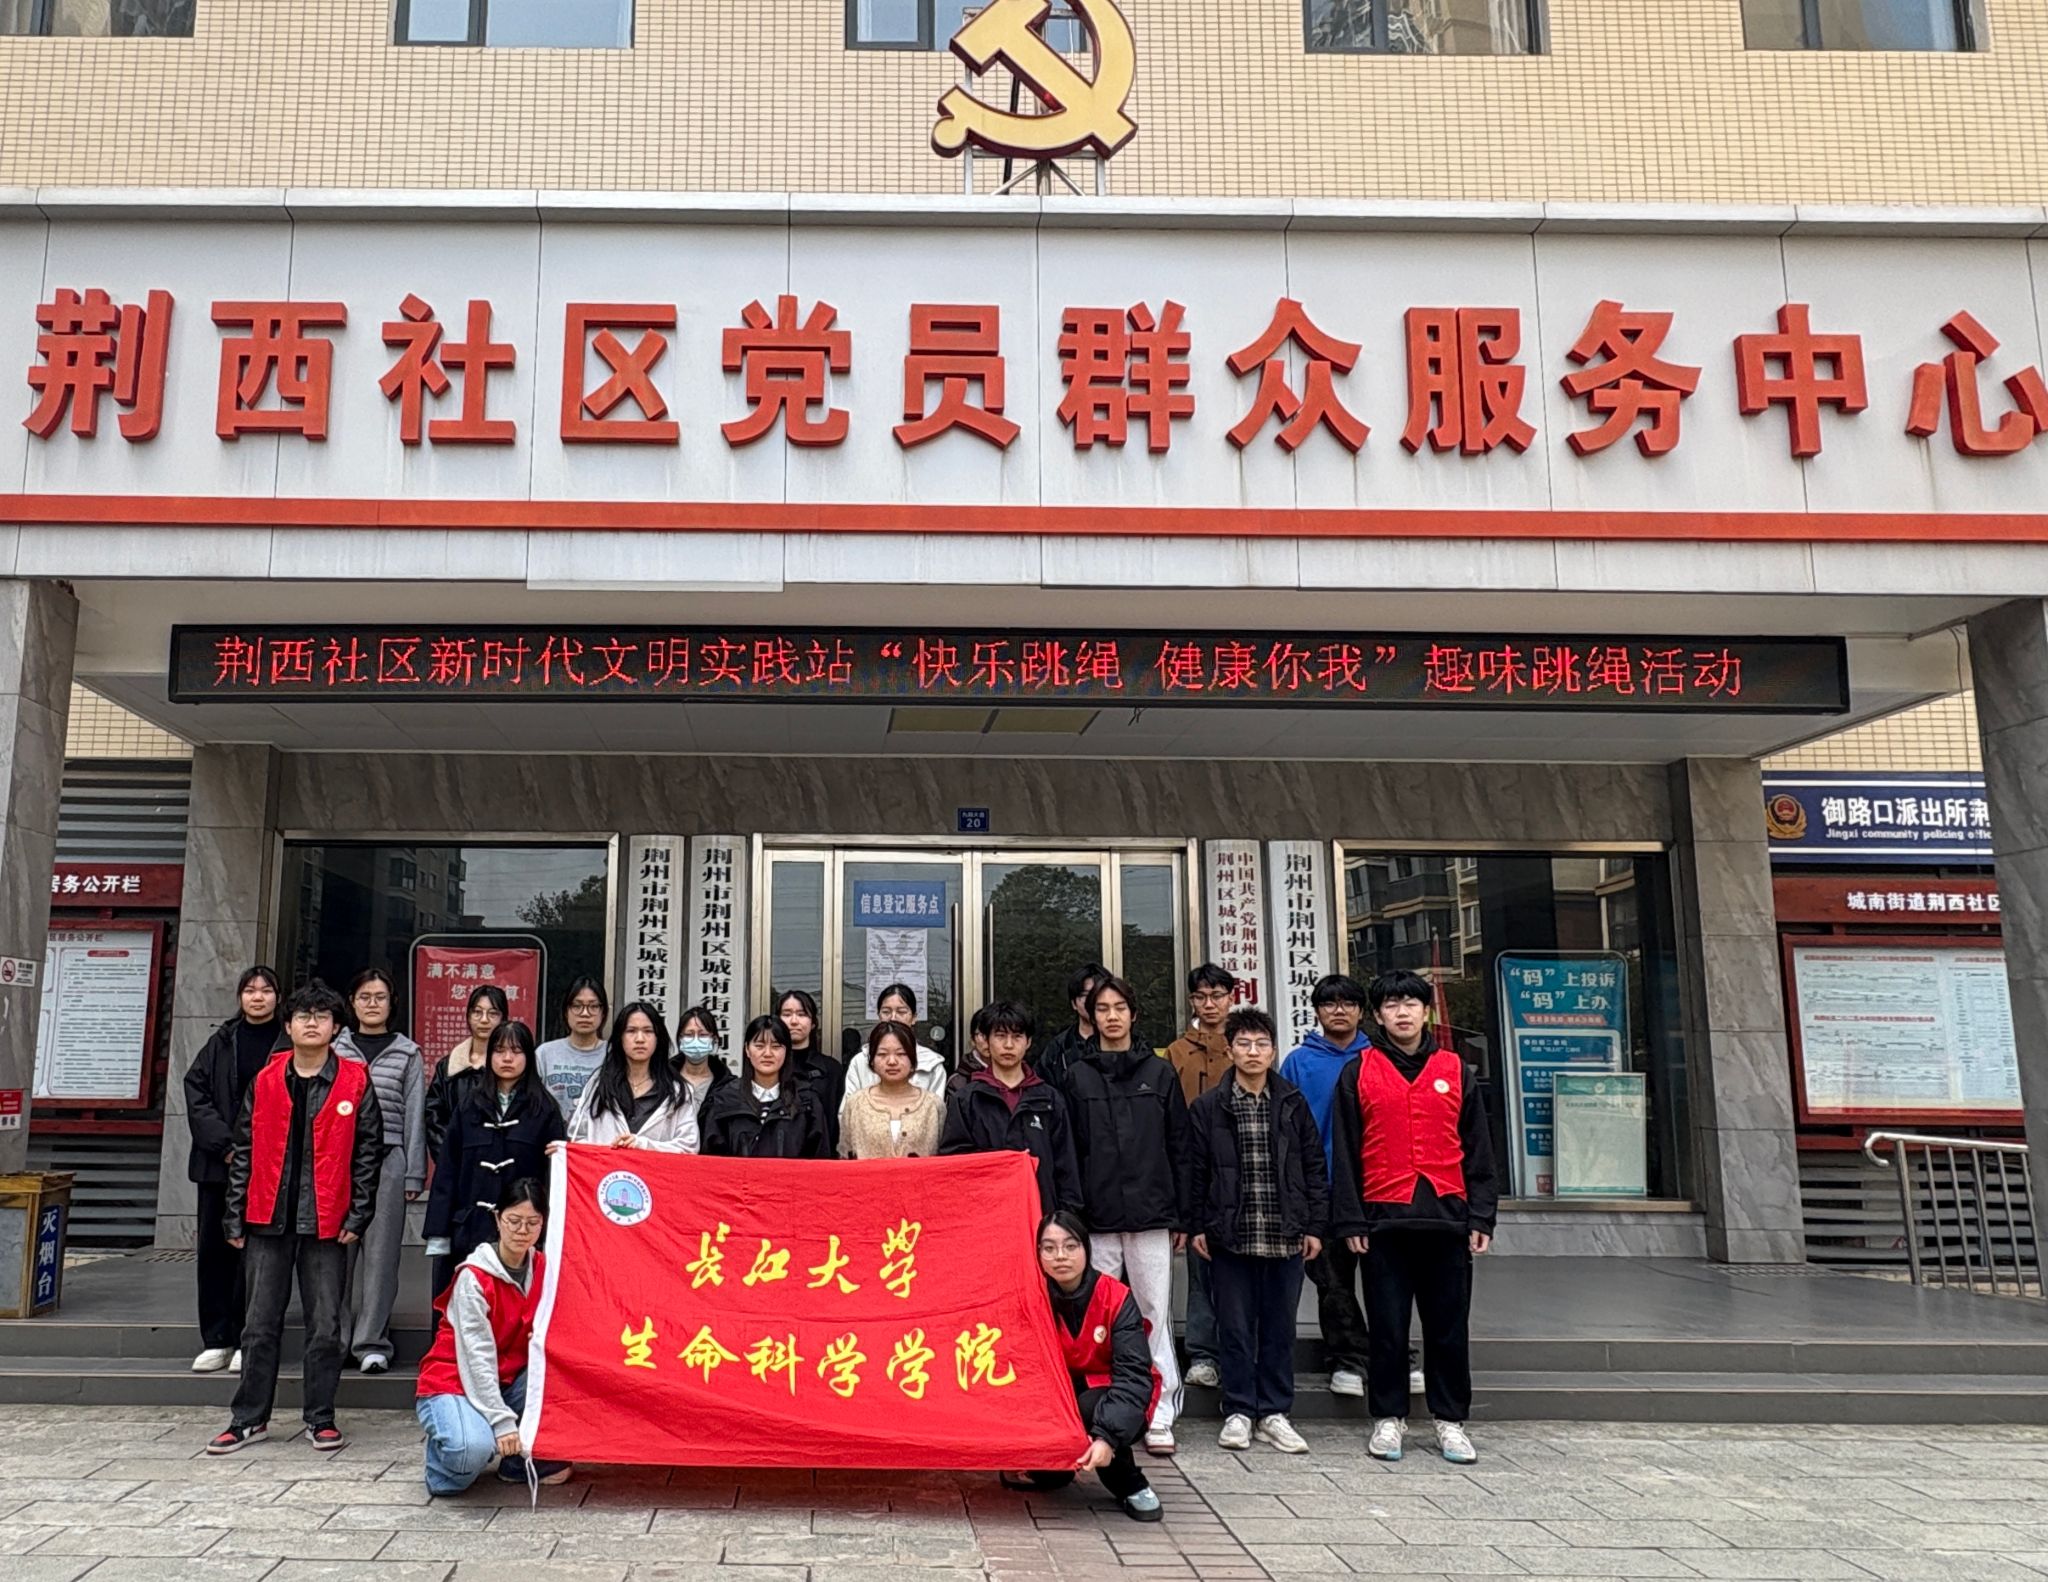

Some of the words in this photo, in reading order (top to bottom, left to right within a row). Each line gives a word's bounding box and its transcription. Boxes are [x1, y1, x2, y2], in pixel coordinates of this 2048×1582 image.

[22, 286, 2048, 457] 荆西社区党员群众服务中心
[966, 818, 981, 828] 20
[1826, 828, 1858, 840] Jingxi
[1862, 829, 1919, 841] community
[1923, 829, 1964, 841] policing
[861, 893, 939, 915] 信息登记服务点
[1238, 852, 1258, 972] 中国共产党荆州市
[1847, 892, 2001, 912] 城南街道荆西社区
[427, 963, 496, 979] 满不满意
[38, 1208, 58, 1298] 灭烟台
[619, 1315, 1017, 1400] 生命科学学院
